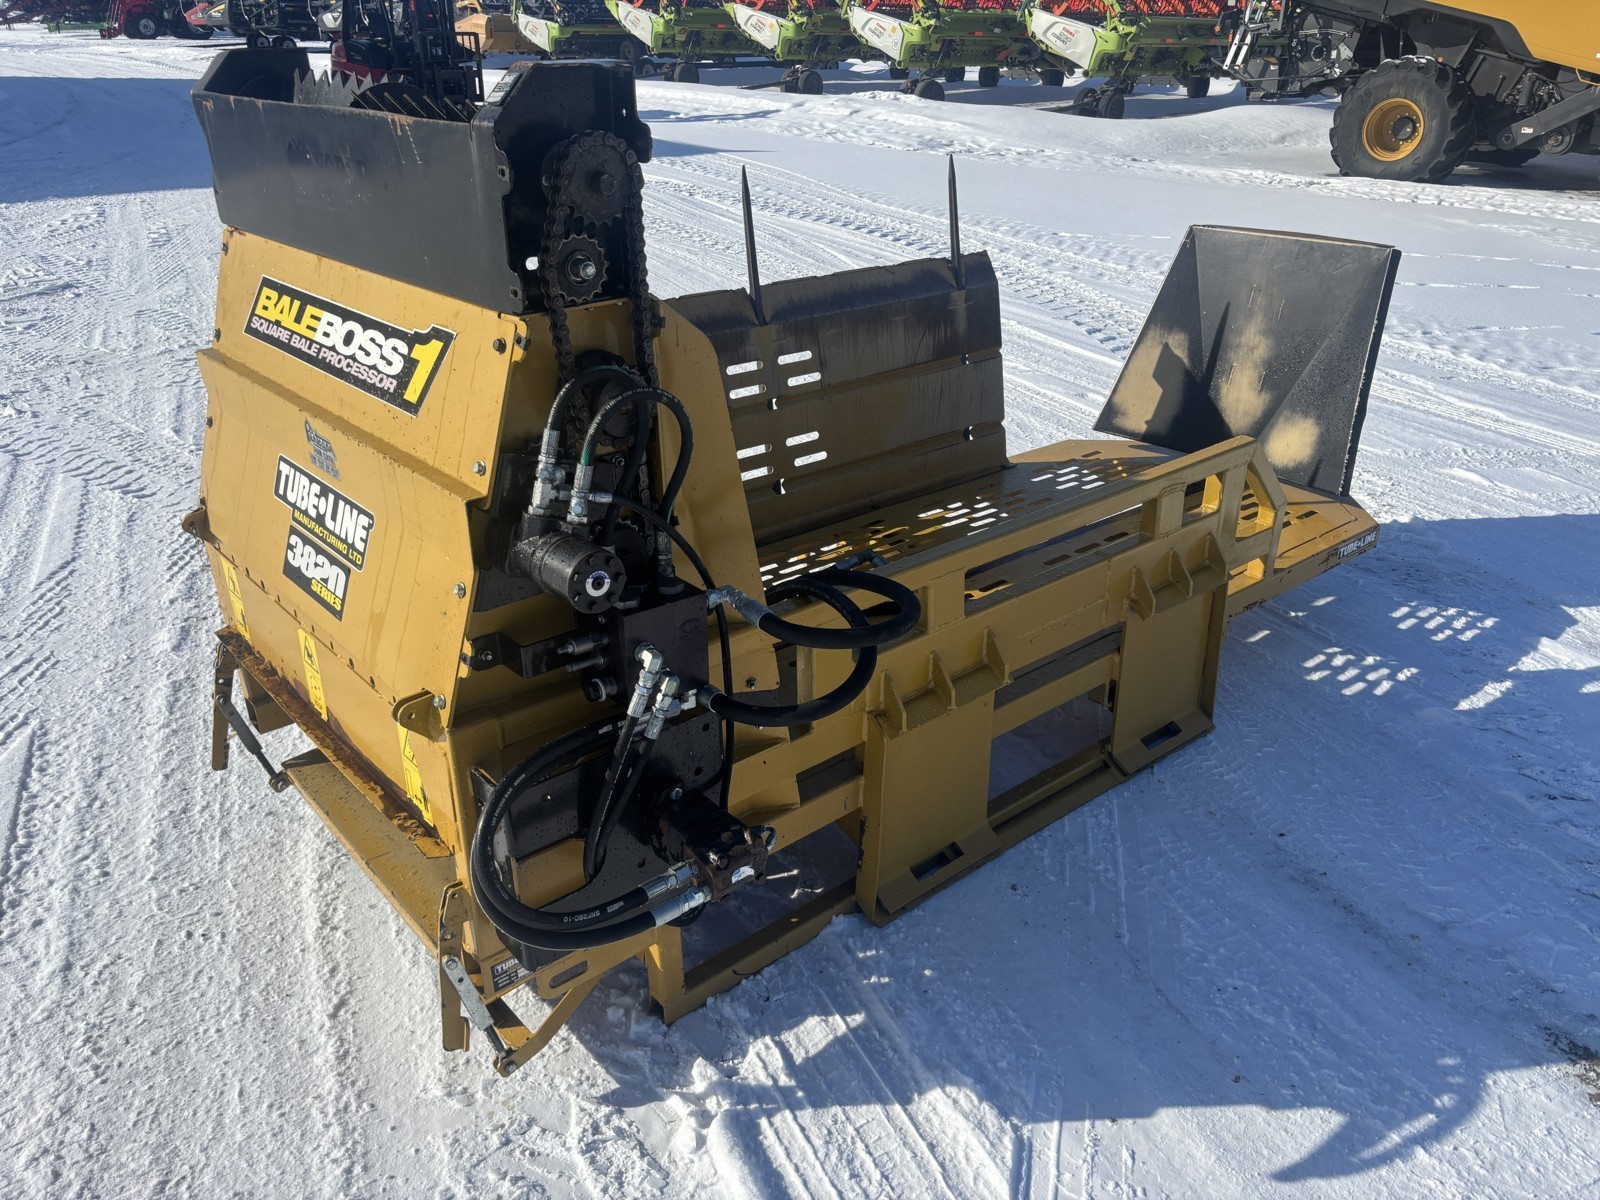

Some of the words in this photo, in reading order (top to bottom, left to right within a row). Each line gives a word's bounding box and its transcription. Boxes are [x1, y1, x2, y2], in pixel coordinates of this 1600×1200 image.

[250, 316, 290, 343] SQUARE
[290, 333, 319, 357] BALE
[318, 348, 397, 392] PROCESSOR
[403, 339, 443, 404] 1
[293, 510, 348, 555] MANUFACTURING
[347, 548, 362, 565] LTD
[311, 579, 342, 611] SERIES
